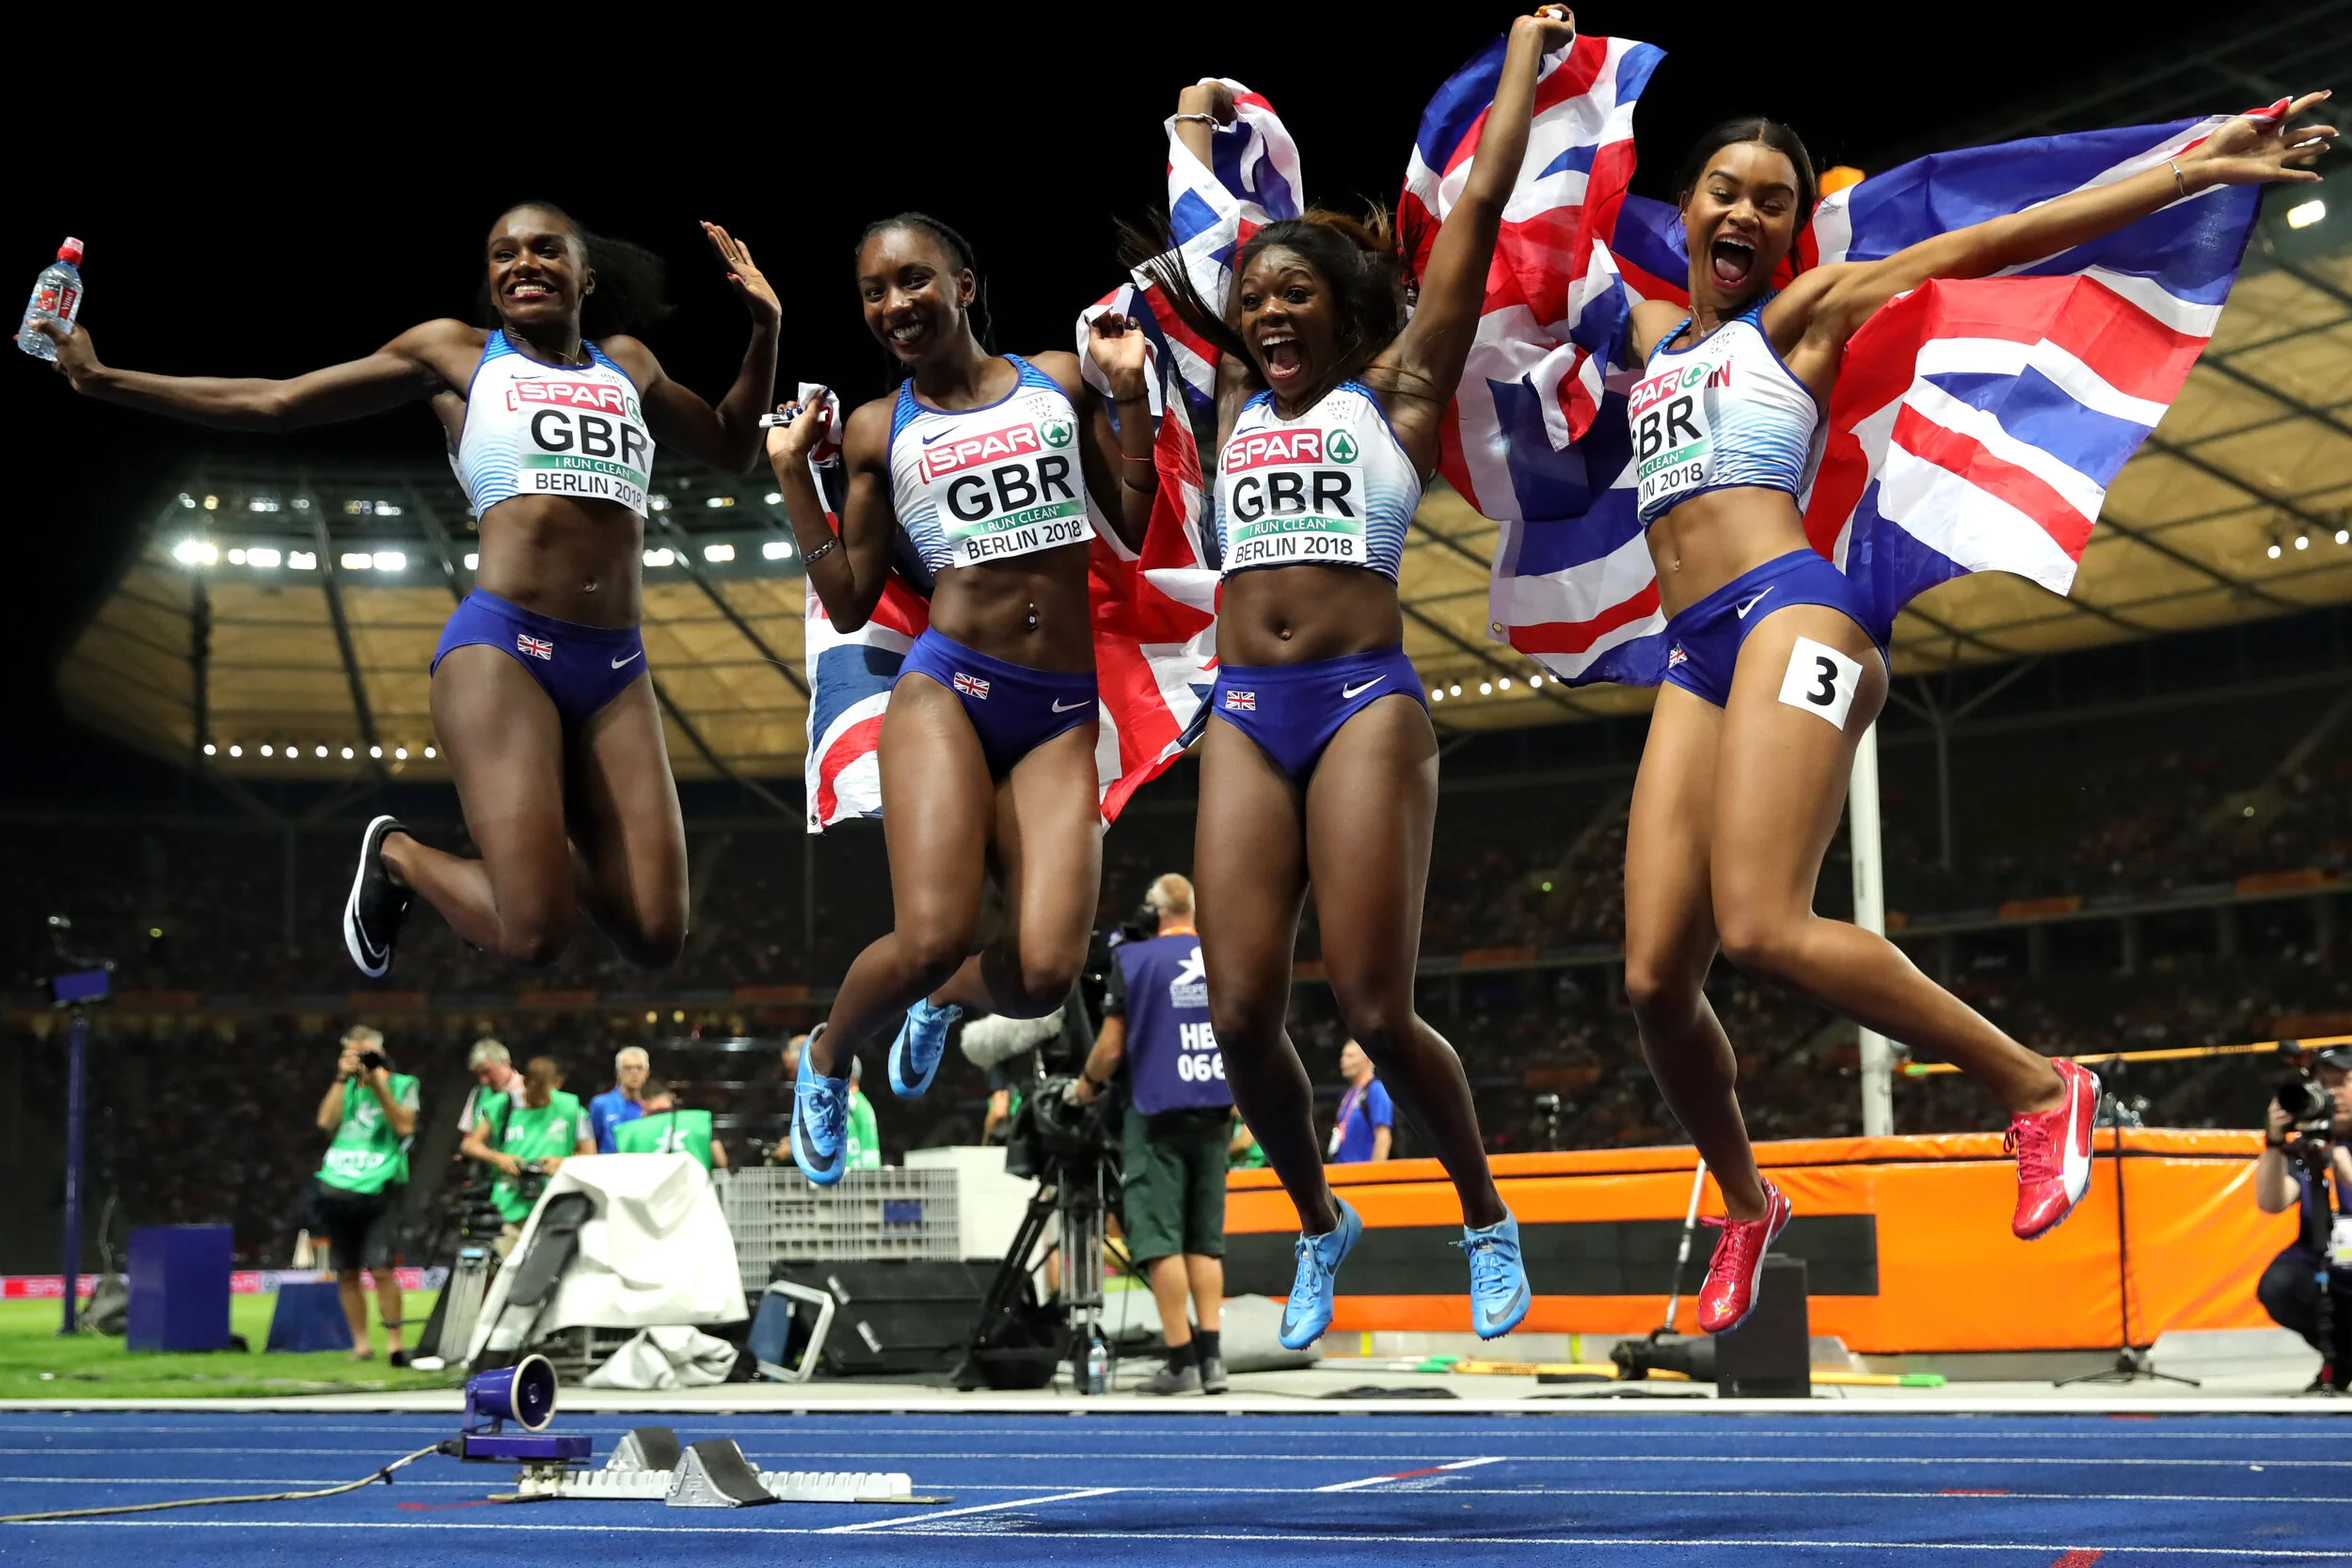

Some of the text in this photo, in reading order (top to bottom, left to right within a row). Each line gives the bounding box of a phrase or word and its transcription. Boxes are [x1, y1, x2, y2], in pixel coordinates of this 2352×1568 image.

[518, 383, 624, 413] SPAR
[531, 409, 648, 474] GBR
[1632, 395, 1703, 464] BR
[555, 457, 560, 467] I
[564, 457, 592, 470] RUN
[929, 426, 1038, 472] SPAR
[1228, 433, 1320, 469] SPAR
[535, 472, 643, 509] BERLIN 2018
[946, 455, 1076, 523] GBR
[1660, 462, 1704, 493] 2018
[1232, 470, 1356, 524] GBR
[966, 519, 1083, 561] BERLIN 2018
[979, 523, 985, 534] I
[988, 516, 1016, 532] RUN
[1248, 525, 1254, 536] I
[1254, 519, 1280, 534] RUN
[1234, 536, 1354, 564] BERLIN 2018
[1806, 656, 1838, 706] 3
